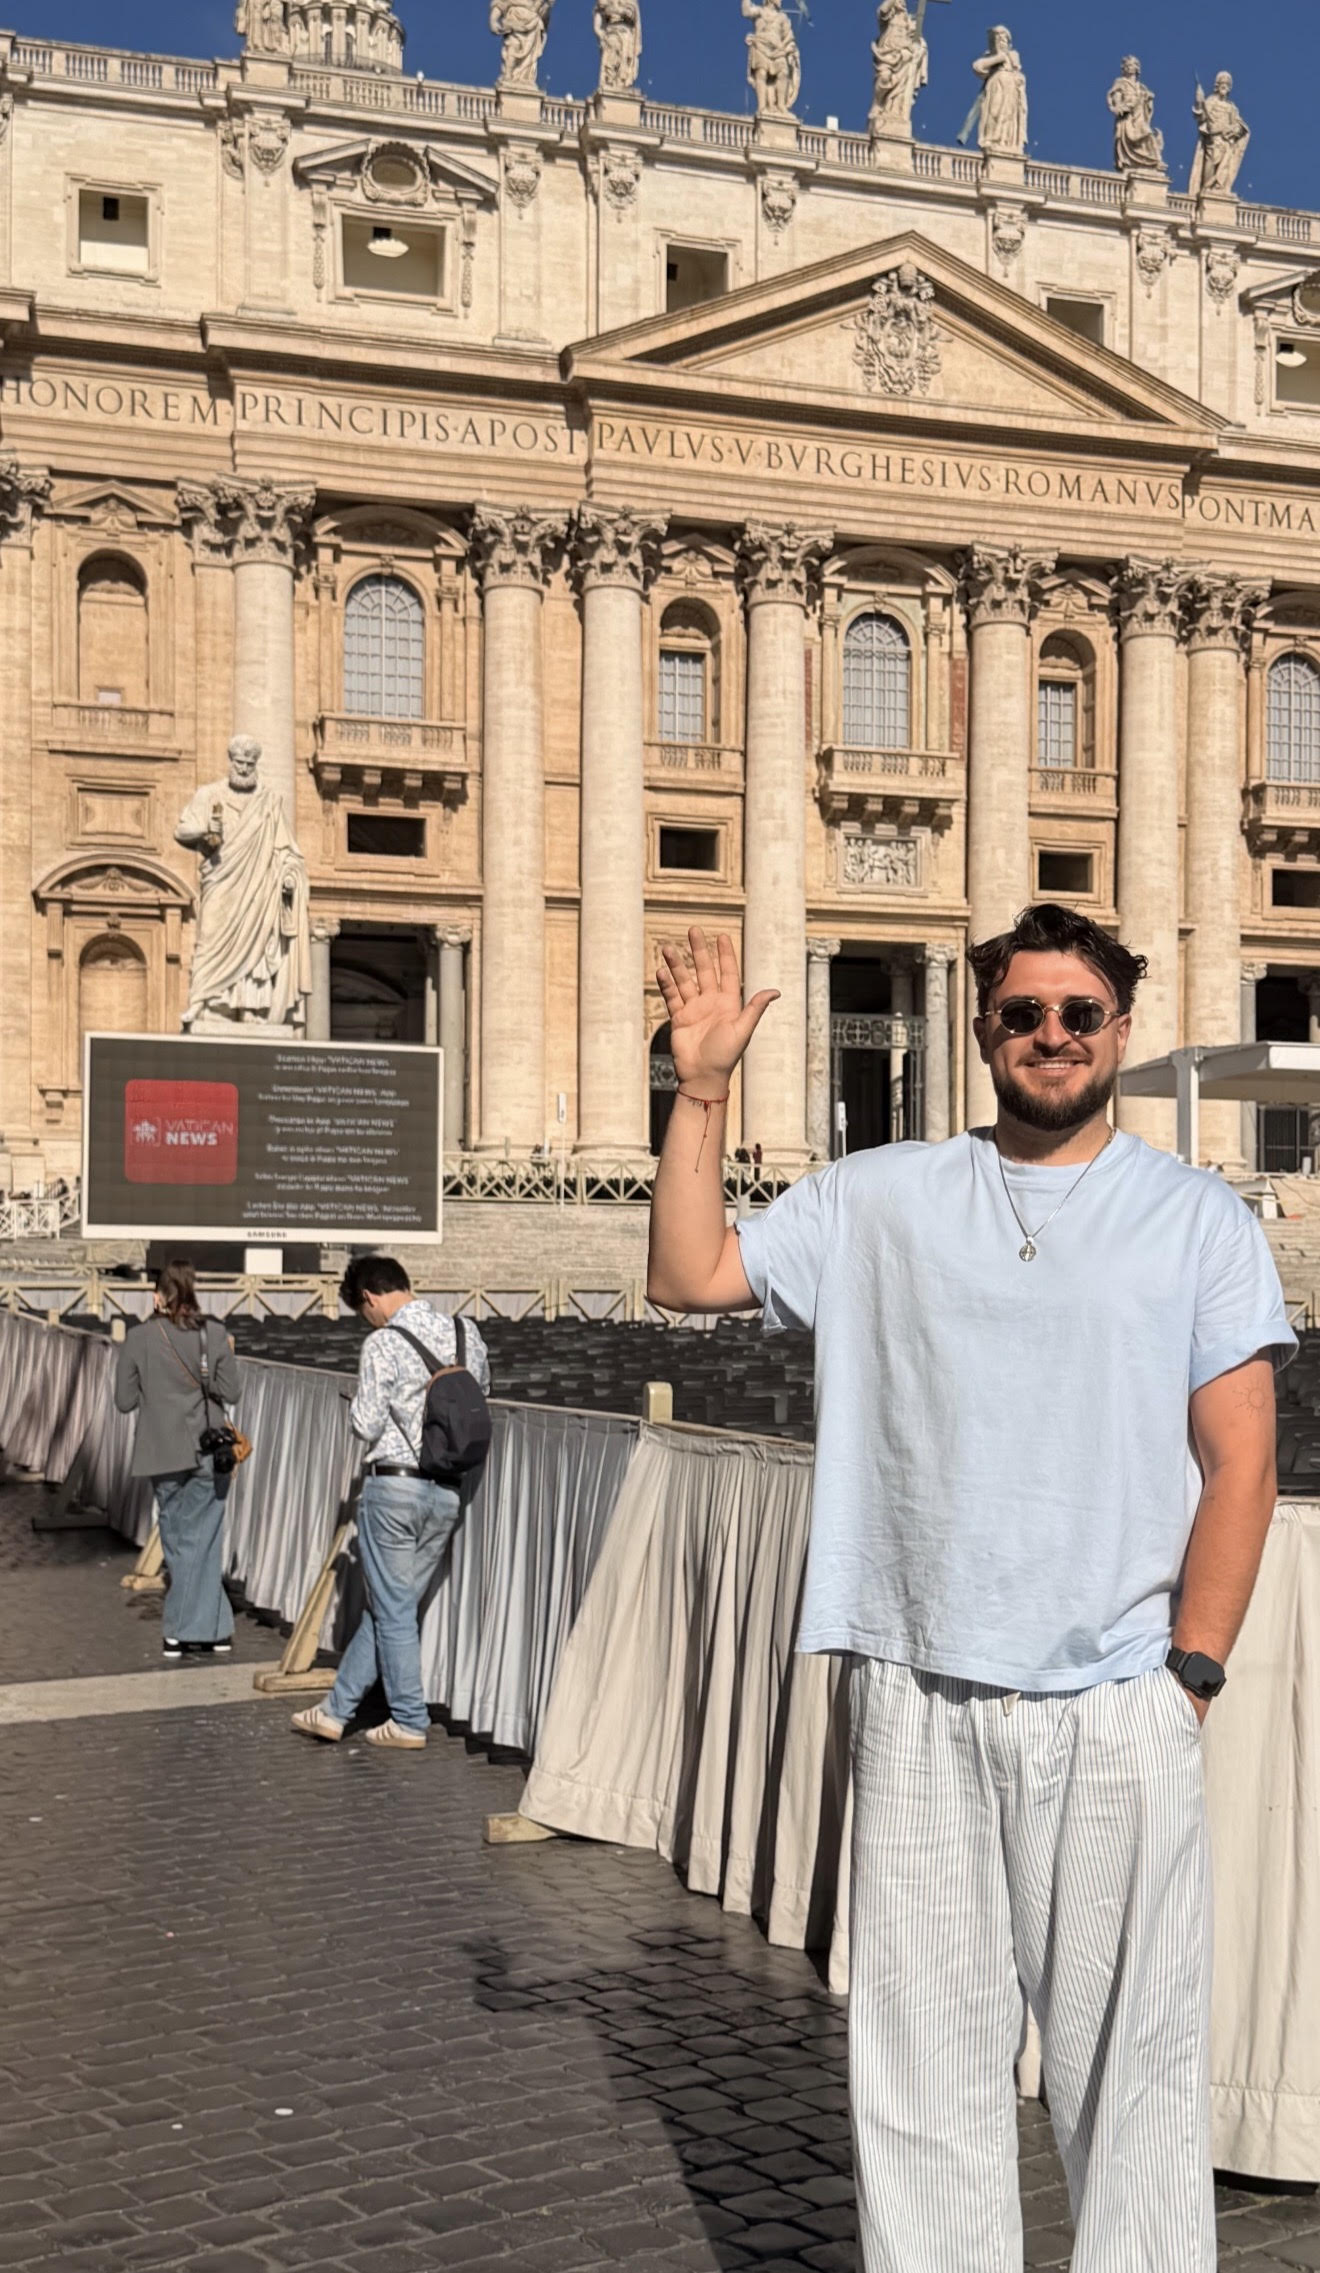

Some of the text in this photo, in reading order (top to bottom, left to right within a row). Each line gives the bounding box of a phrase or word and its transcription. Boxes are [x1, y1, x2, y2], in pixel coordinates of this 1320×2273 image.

[238, 391, 451, 443] PRINCIPIS
[458, 416, 578, 456] APOST
[597, 421, 725, 464] PAVLVS
[732, 438, 755, 465] V
[765, 441, 992, 493] BVRGHESIVS
[1003, 467, 1181, 511] ROMANVS
[165, 1118, 234, 1136] VATICAN
[165, 1131, 218, 1146] NEWS
